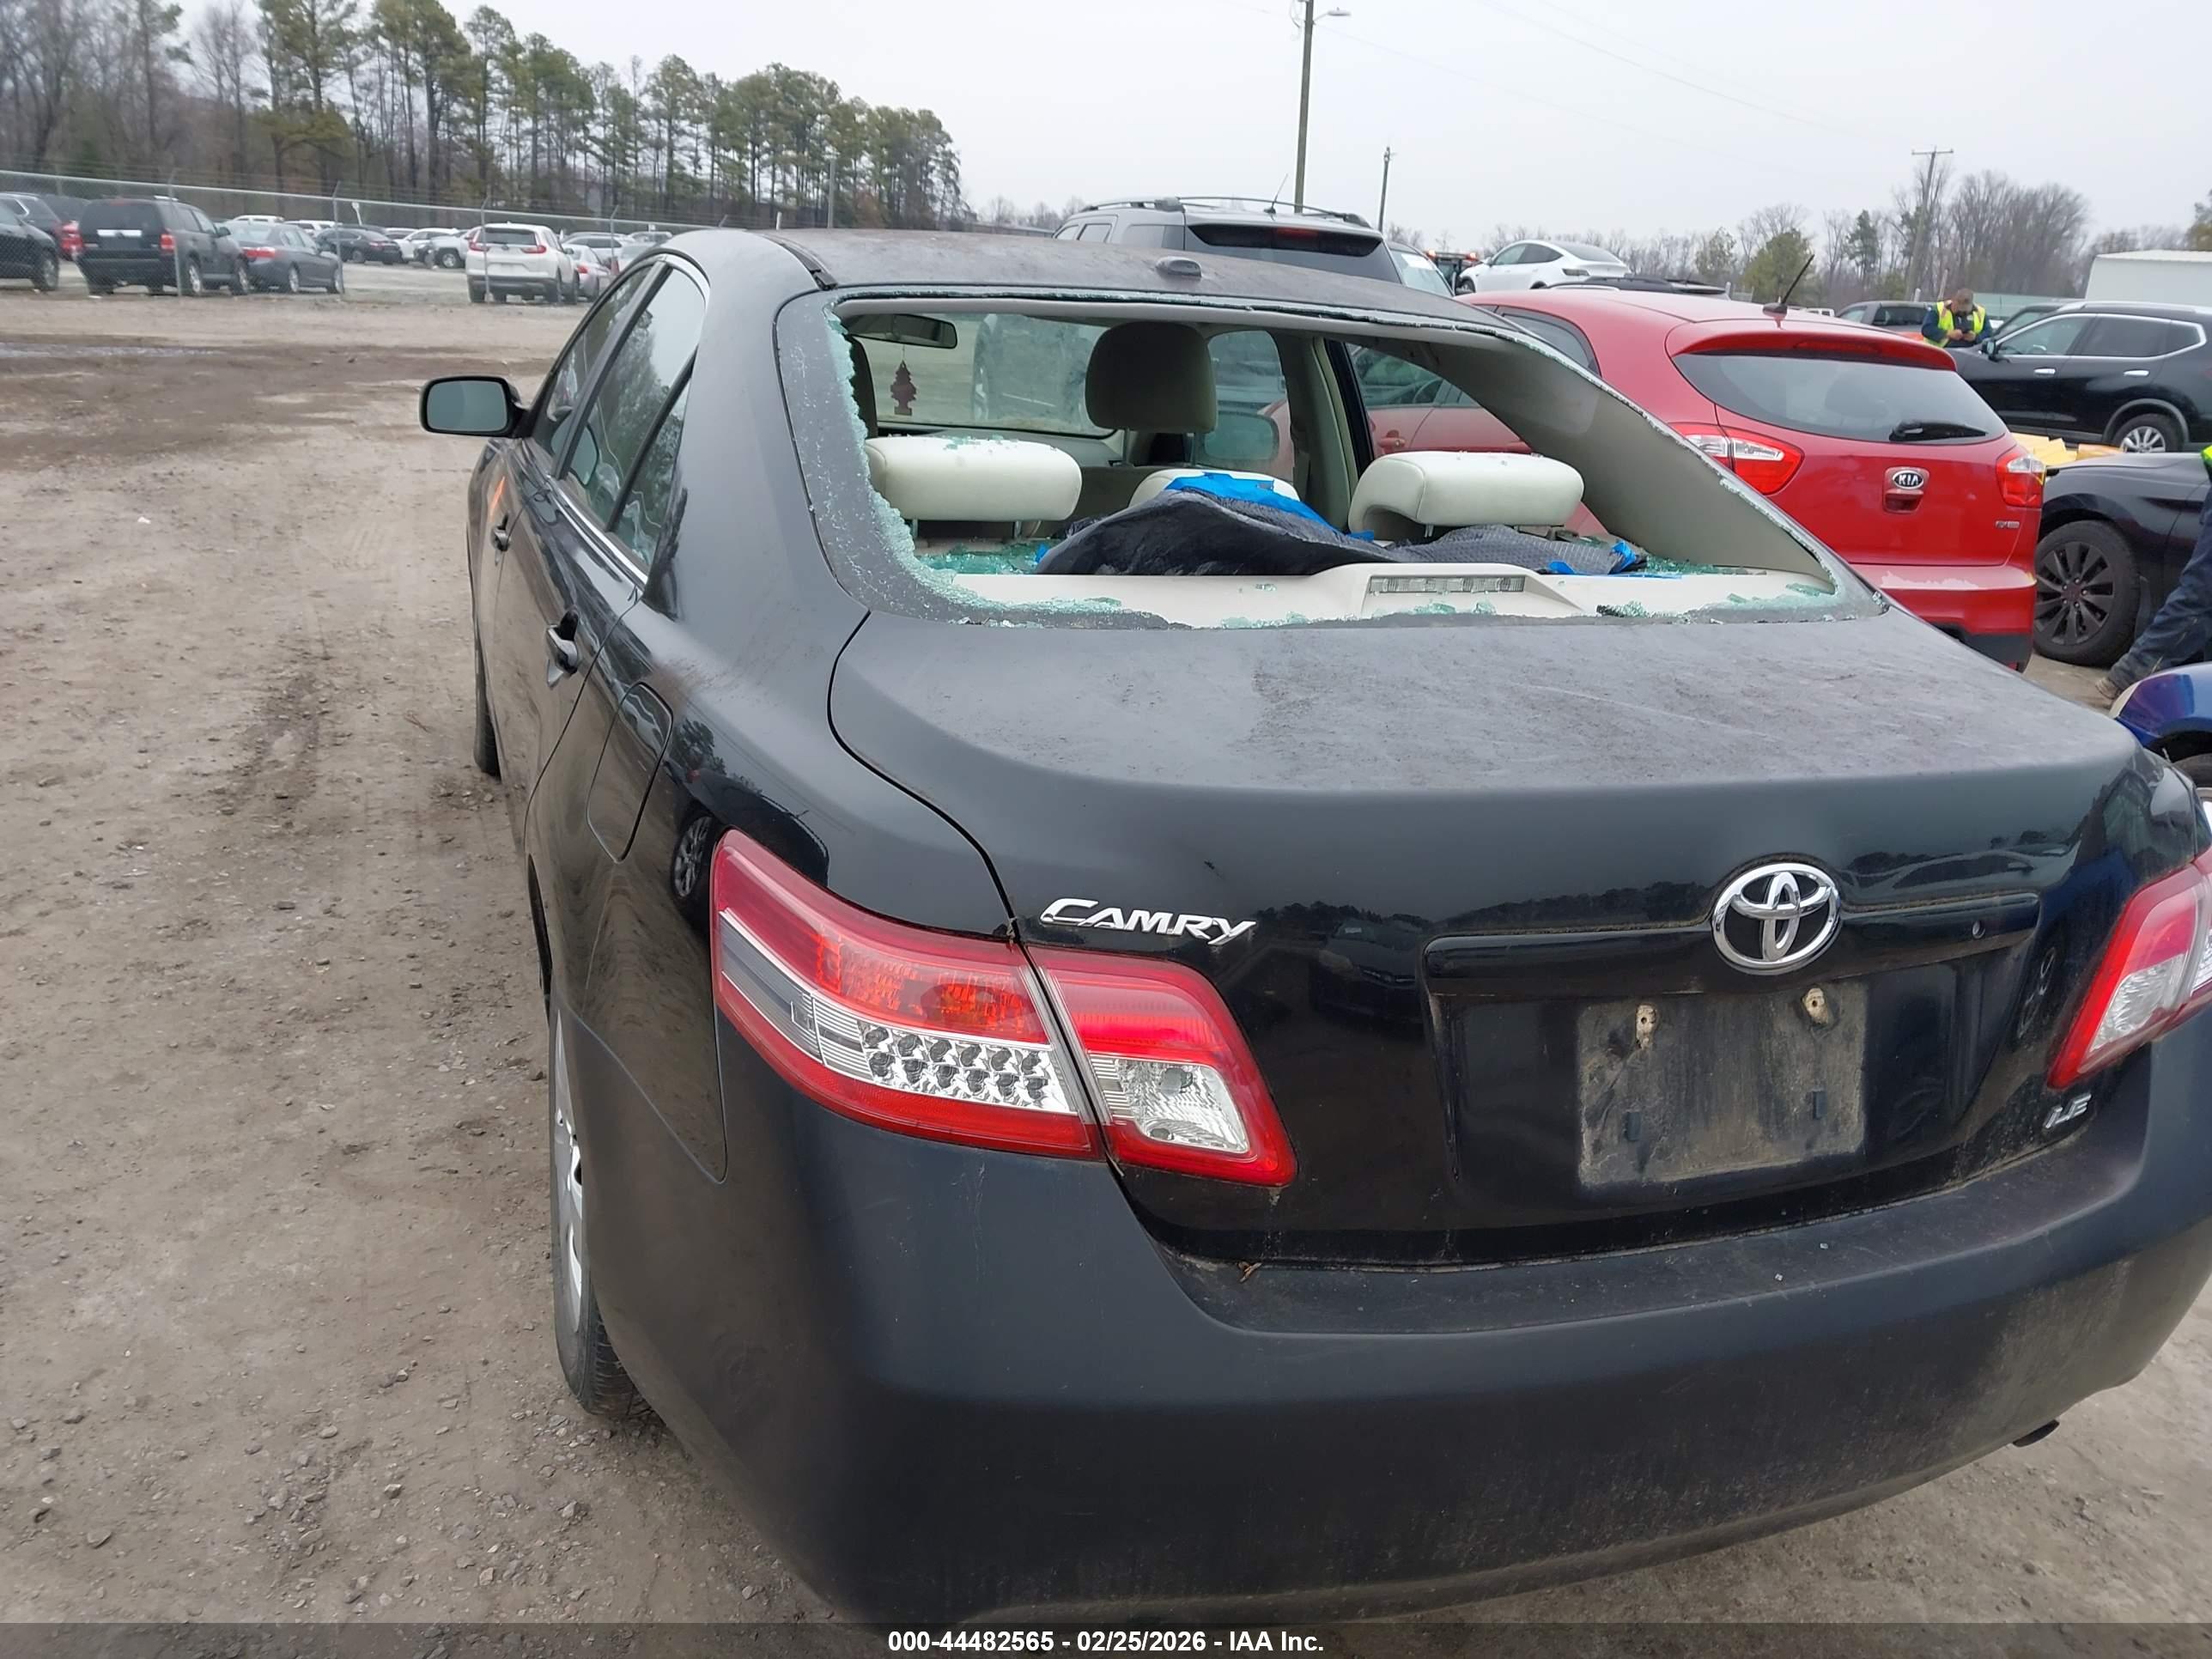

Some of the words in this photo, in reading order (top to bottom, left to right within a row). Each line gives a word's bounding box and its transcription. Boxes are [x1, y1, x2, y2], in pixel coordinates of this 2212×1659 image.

[1899, 474, 1919, 486] KIA
[1040, 897, 1257, 945] CAMRY
[2044, 1093, 2092, 1129] LE
